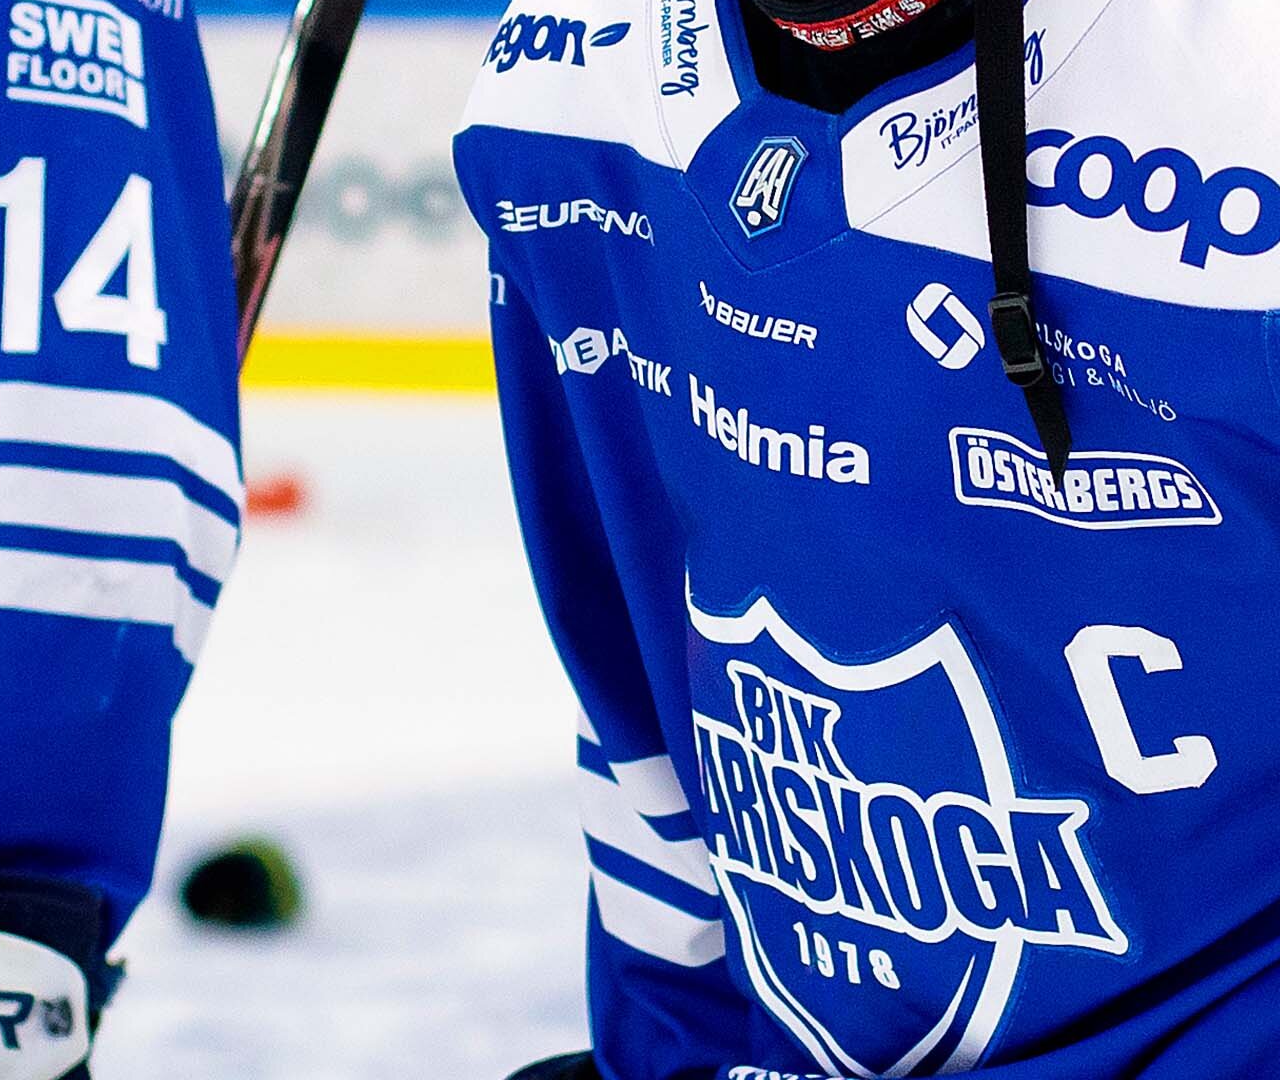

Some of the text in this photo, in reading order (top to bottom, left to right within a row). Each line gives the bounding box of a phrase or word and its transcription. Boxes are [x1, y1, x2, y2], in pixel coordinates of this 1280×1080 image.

[9, 2, 122, 67] SWE
[7, 52, 125, 100] FLOOR
[716, 300, 818, 350] BAUER
[689, 373, 871, 486] Helmia
[967, 436, 1203, 514] ÖSTERBERGS
[732, 666, 842, 788] BIK
[1064, 624, 1218, 795] C
[692, 723, 1098, 936] ARLSKOGA
[793, 921, 901, 990] 1978
